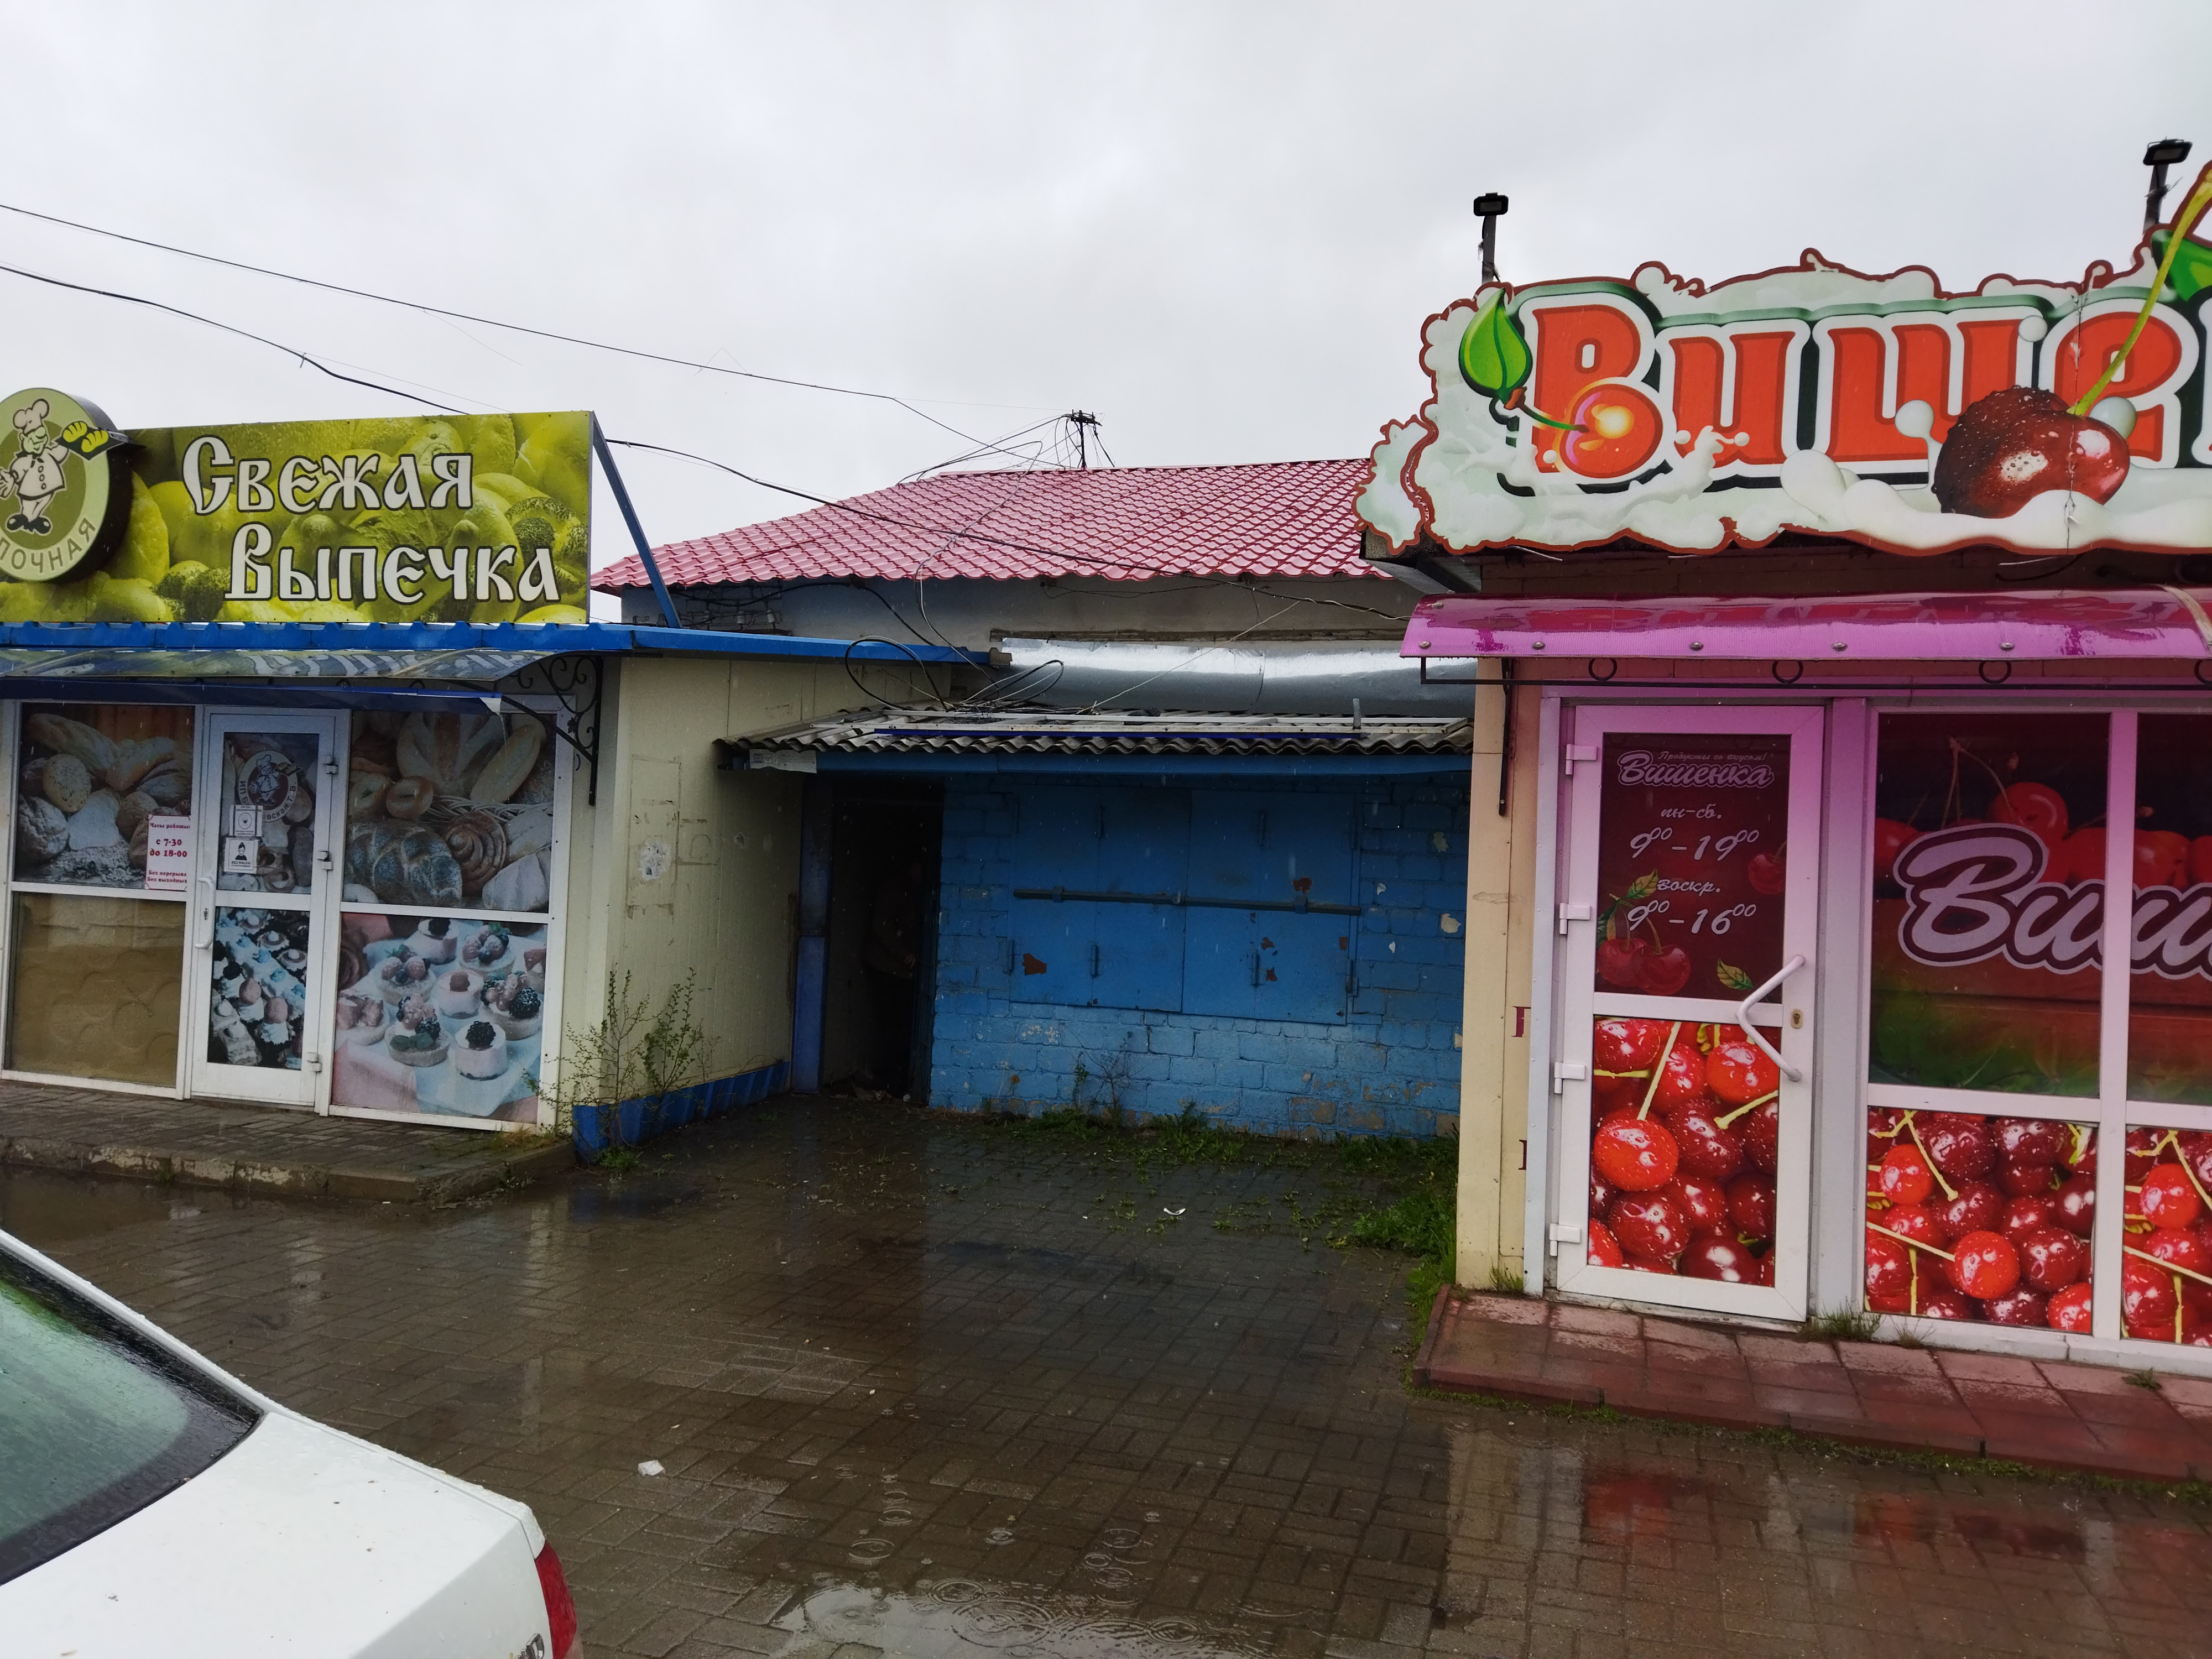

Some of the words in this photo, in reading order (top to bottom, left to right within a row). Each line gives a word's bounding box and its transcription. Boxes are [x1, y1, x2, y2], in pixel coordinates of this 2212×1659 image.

[1519, 291, 2212, 488] Више
[181, 434, 474, 516] Свежая
[223, 522, 561, 605] Выпечка
[1618, 750, 1773, 787] Вишенка
[1657, 879, 1721, 896] воскр.
[1896, 826, 2212, 978] Виш
